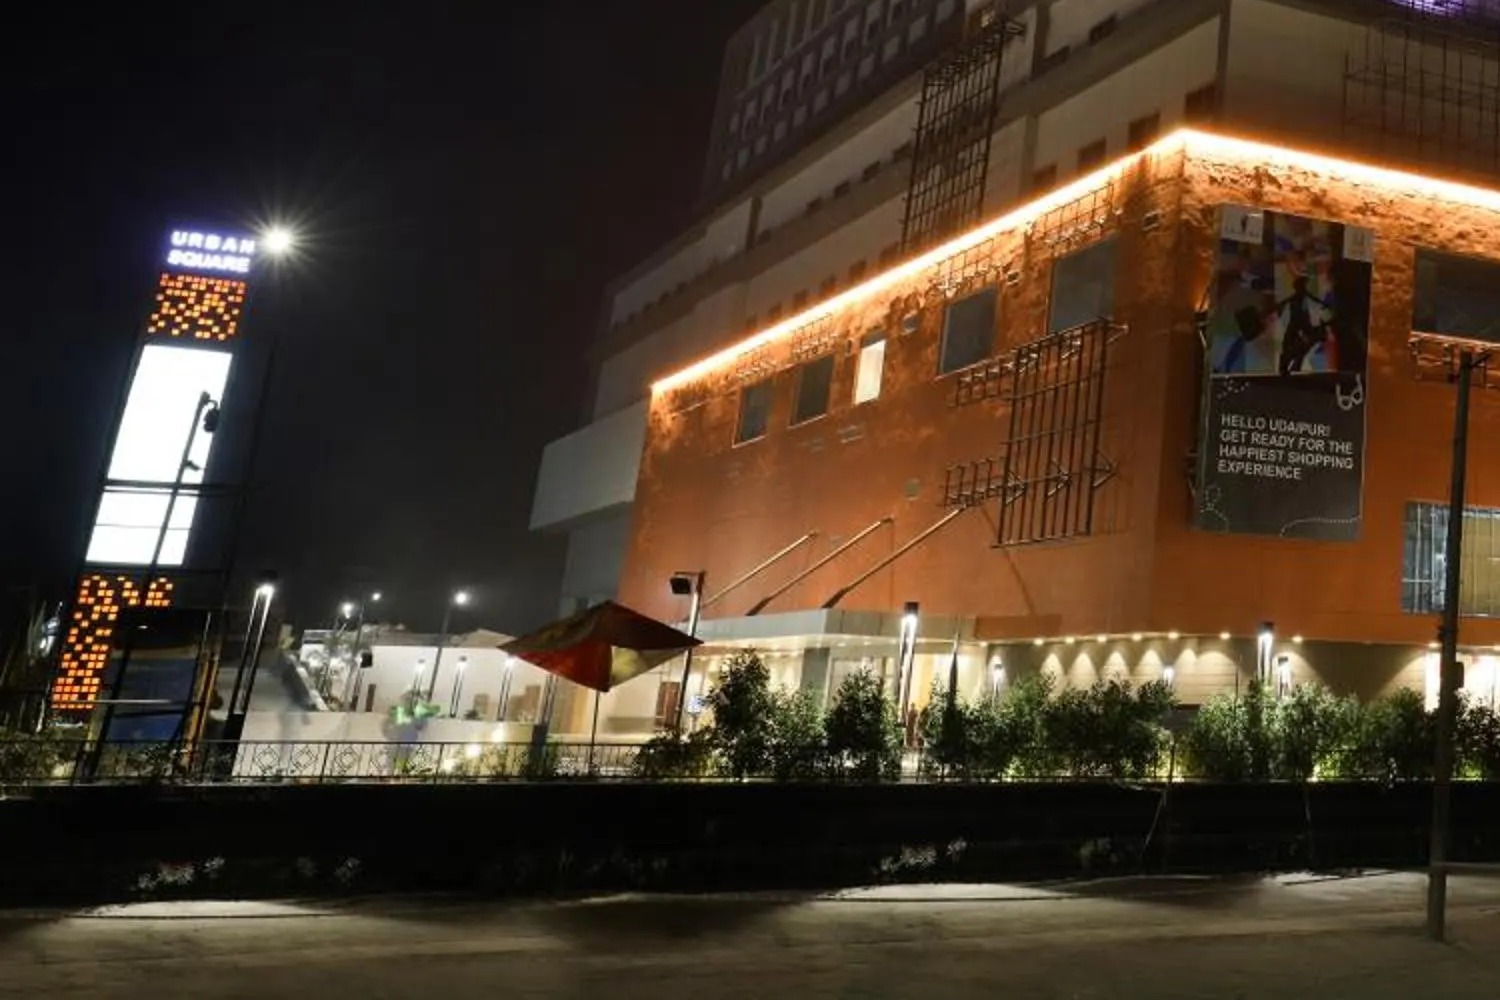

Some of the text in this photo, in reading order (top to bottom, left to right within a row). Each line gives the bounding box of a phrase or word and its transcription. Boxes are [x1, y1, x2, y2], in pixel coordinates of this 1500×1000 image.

[171, 231, 255, 255] URBAN
[167, 249, 250, 272] SQUARE
[1221, 413, 1266, 429] HELLO
[1219, 429, 1353, 455] GET READY FOR THE
[1219, 443, 1354, 470] HAPPIEST SHOPPING
[1217, 459, 1302, 479] EXPERIENCE
